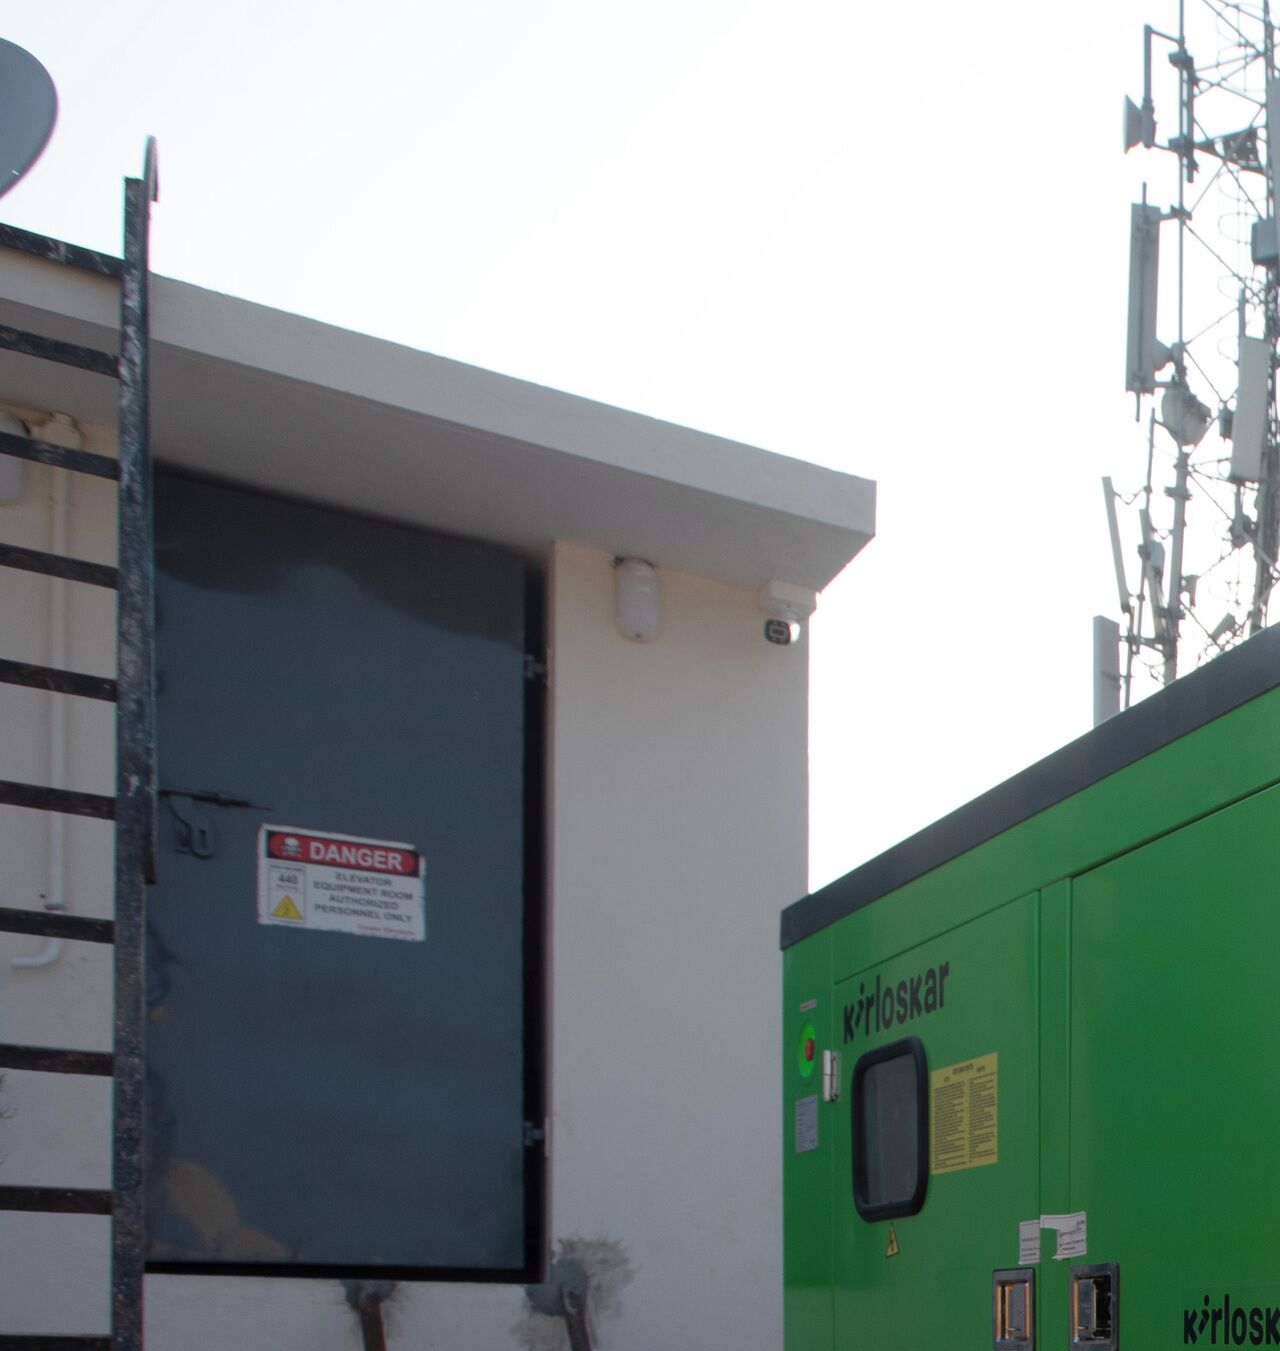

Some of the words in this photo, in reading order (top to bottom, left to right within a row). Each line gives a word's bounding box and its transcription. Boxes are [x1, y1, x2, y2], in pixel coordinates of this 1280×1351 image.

[309, 842, 404, 871] DANGER
[335, 872, 392, 886] ELEVATOR
[313, 881, 377, 895] EQUIPMENT
[381, 887, 414, 900] ROOM
[329, 894, 399, 910] AUTHORIZED
[314, 904, 380, 919] PERSONNEL
[384, 913, 413, 923] ONLY
